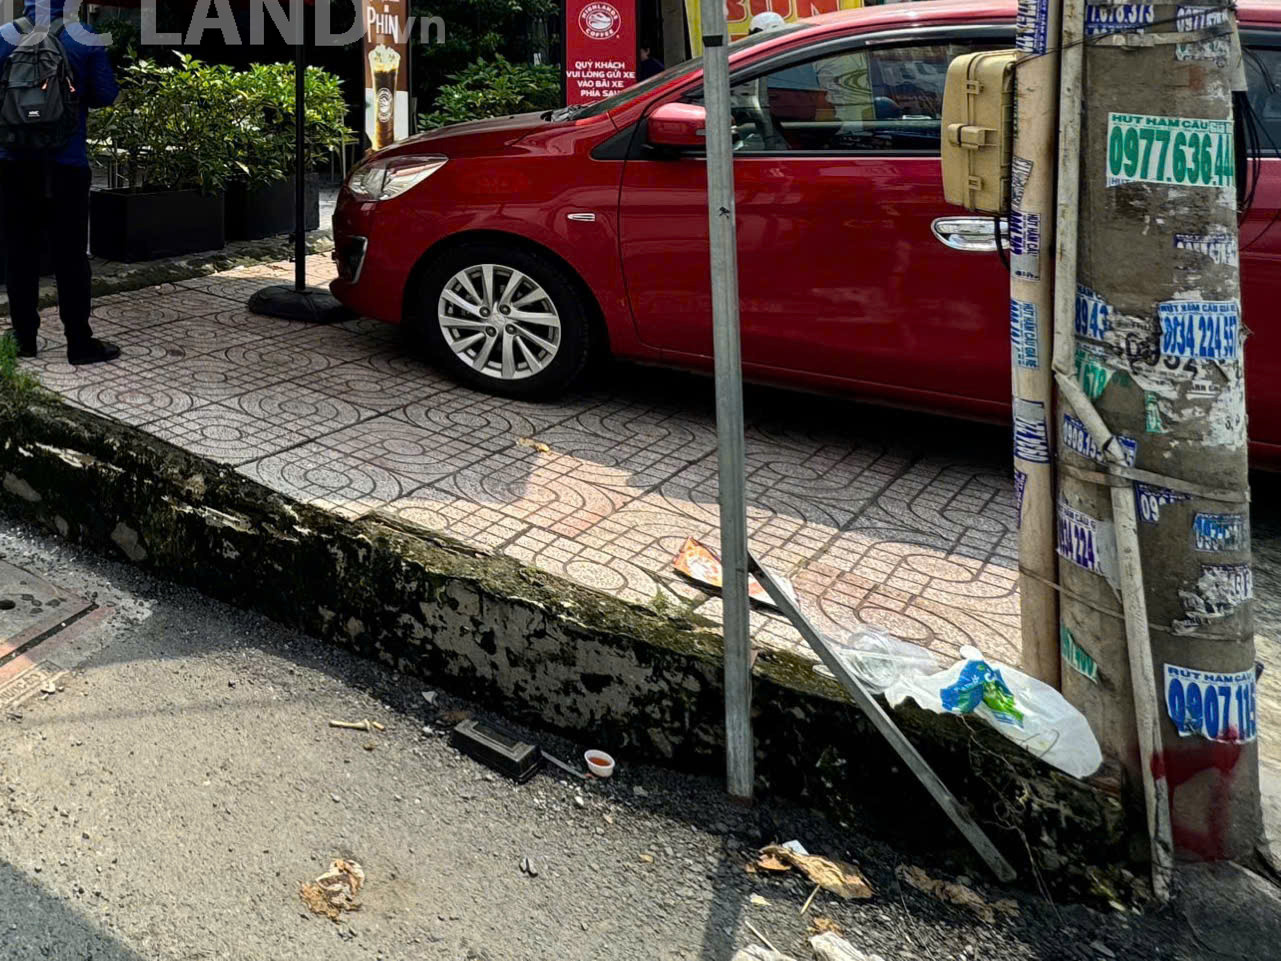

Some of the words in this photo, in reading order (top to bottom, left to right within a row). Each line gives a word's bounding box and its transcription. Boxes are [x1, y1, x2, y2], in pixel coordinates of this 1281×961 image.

[581, 3, 619, 20] HIGHLANDS
[585, 28, 614, 38] COFFEE
[575, 58, 593, 69] QUÝ
[594, 59, 625, 69] KHÁCH
[566, 70, 581, 78] VUI
[582, 68, 605, 78] LÒNG
[623, 71, 636, 79] XE
[577, 78, 595, 88] VÀO
[611, 80, 625, 88] XE
[580, 88, 601, 97] PHÍA
